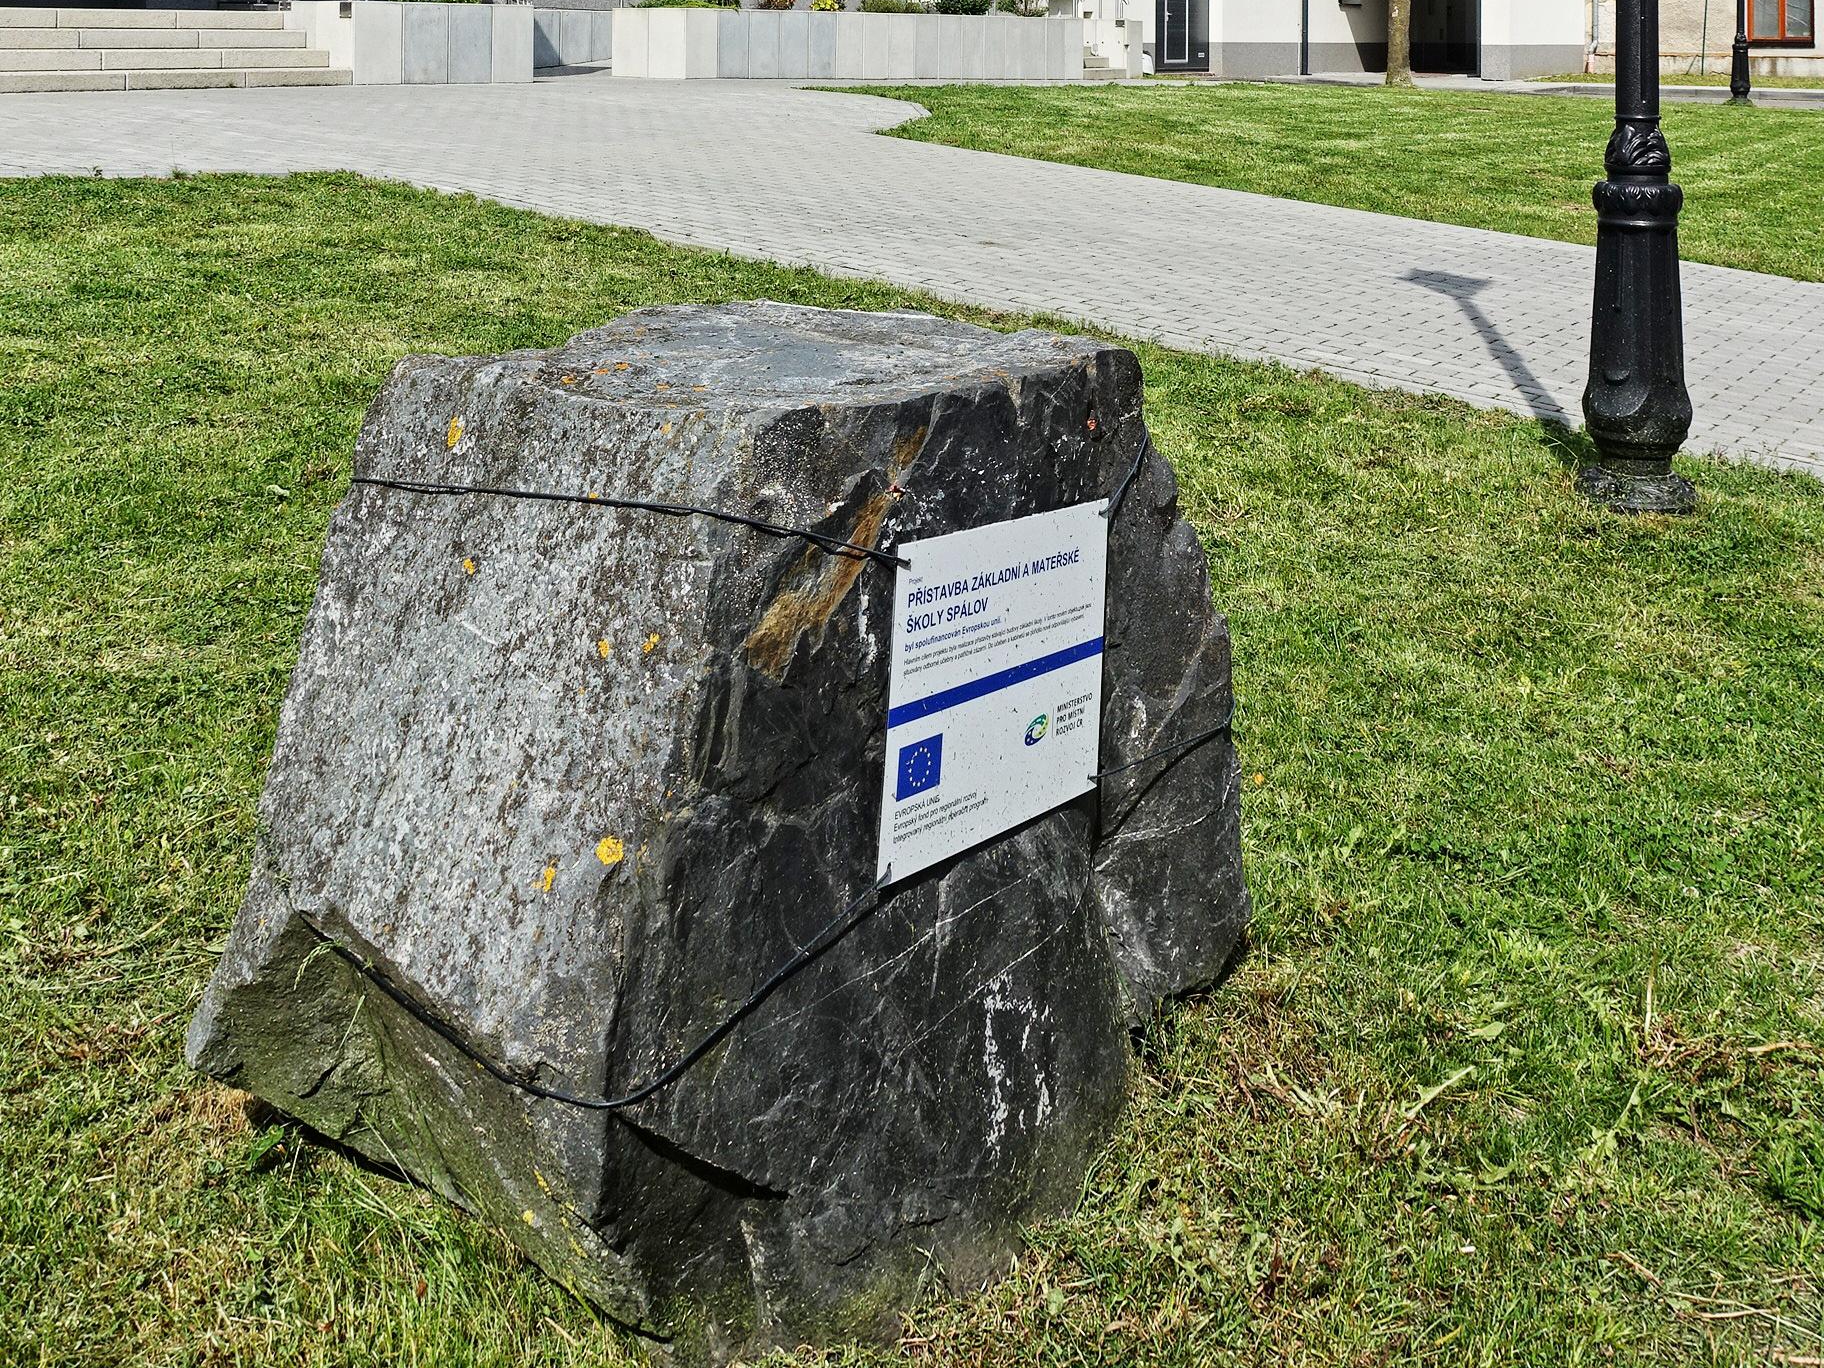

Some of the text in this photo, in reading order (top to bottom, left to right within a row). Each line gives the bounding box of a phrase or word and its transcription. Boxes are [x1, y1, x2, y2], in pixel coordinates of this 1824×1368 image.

[908, 547, 1079, 608] PŘÍSTAVBA ZÁKLADNÍ A MATEŘSKÉ
[907, 597, 988, 633] ŠKOLY SPÁLOV
[905, 642, 914, 653] byl
[915, 630, 961, 649] spolufinancován
[962, 622, 990, 634] Evropskou
[1057, 693, 1092, 713] MINISTERSTVO
[1057, 708, 1084, 724] PRO MÍSTNÍ
[1056, 718, 1083, 736] ROZVOJ ČR
[894, 789, 977, 832] Evropský fond pro regionální rozvoj
[895, 799, 925, 820] EVROPSKÁ
